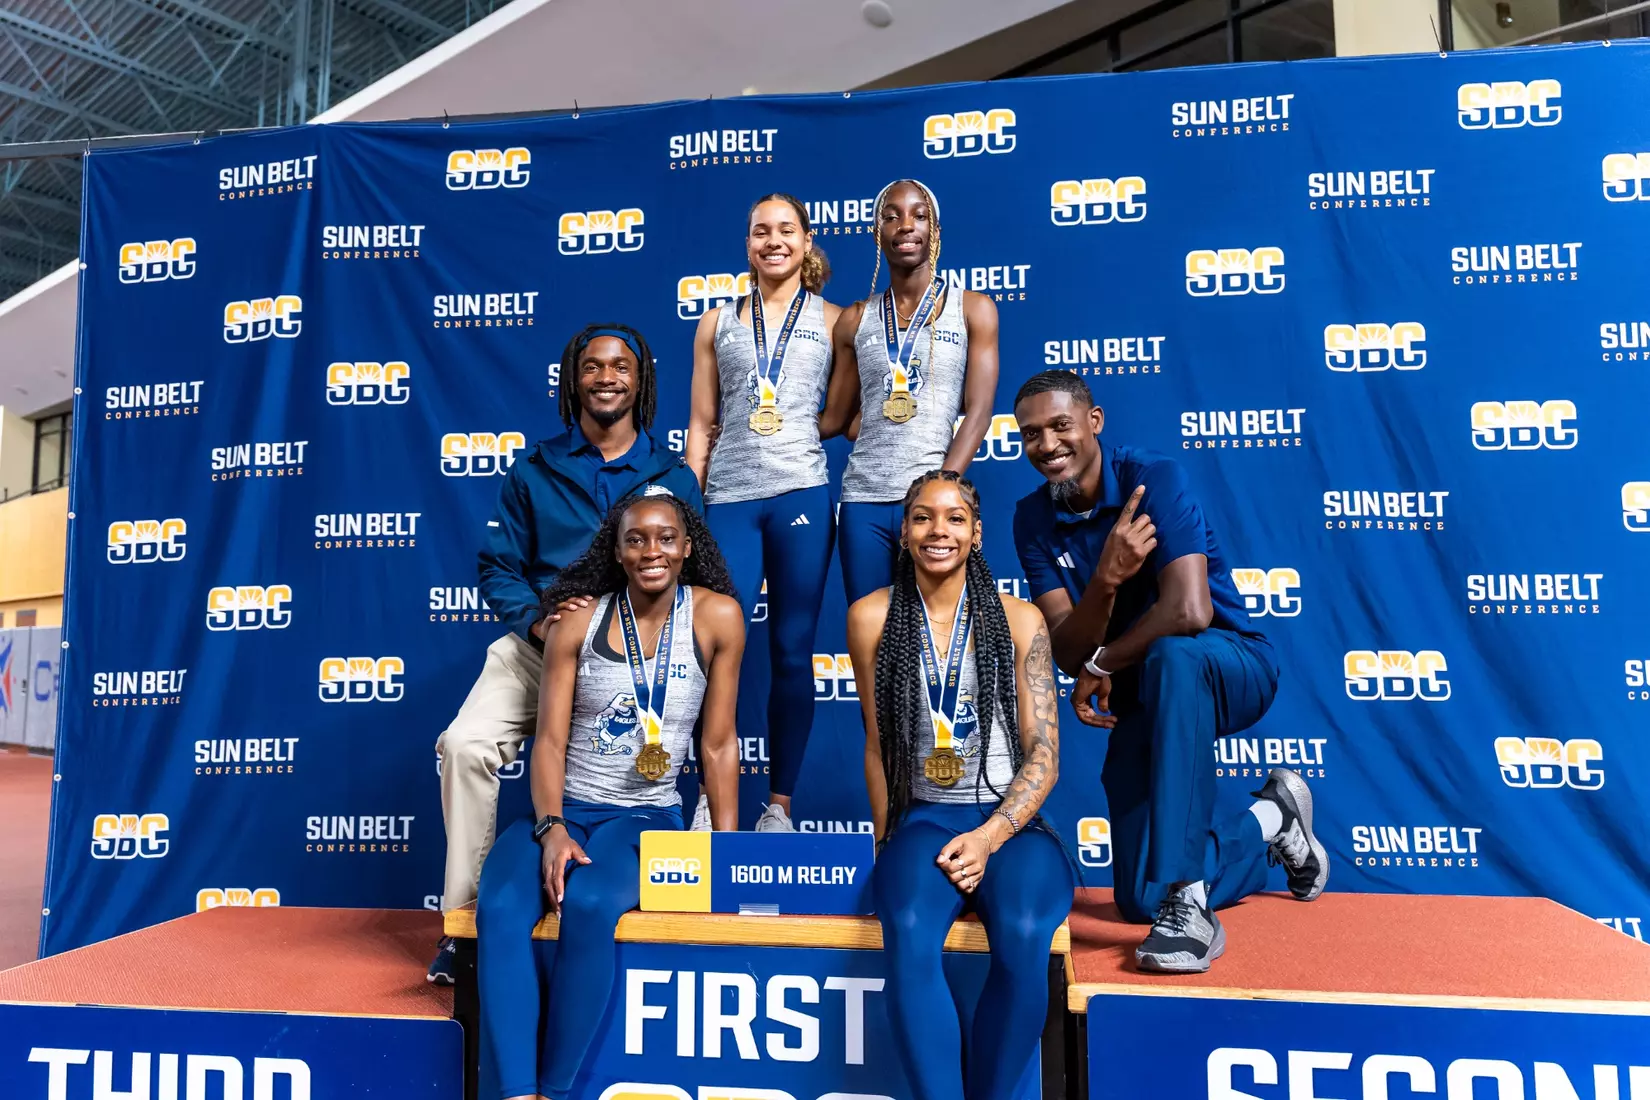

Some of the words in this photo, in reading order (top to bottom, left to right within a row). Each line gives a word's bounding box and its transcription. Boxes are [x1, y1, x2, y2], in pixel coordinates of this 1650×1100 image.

[1172, 100, 1226, 125] SUN
[1233, 94, 1294, 122] BELT
[1458, 79, 1562, 129] SBC
[924, 109, 1016, 159] SBC
[1173, 123, 1288, 137] CONFERENCE
[670, 130, 717, 158] SUN
[723, 129, 777, 152] BELT
[220, 164, 263, 189] SUN
[268, 155, 317, 184] BELT
[446, 147, 531, 190] SBC
[670, 155, 772, 169] CONFERENCE
[220, 182, 312, 200] CONFERENCE
[1309, 172, 1365, 197] SUN
[1371, 169, 1435, 195] BELT
[804, 200, 839, 224] UN
[844, 198, 875, 222] BE
[1051, 176, 1146, 226] SBC
[1310, 198, 1430, 209] CONFERENCE
[323, 226, 369, 247] SUN
[374, 225, 425, 247] BELT
[558, 208, 644, 255] SBC
[810, 225, 875, 236] NFEREN
[119, 238, 196, 283] SBC
[323, 250, 418, 259] CONFERENCE
[1452, 246, 1510, 272] SUN
[1516, 243, 1582, 269] BELT
[971, 264, 1031, 291] BELT
[1186, 247, 1285, 296] SBC
[1454, 272, 1577, 284] CONFERENCE
[434, 295, 480, 317] SUN
[485, 292, 538, 315] BELT
[224, 295, 302, 343] SBC
[434, 318, 533, 328] CONFERENCE
[794, 329, 819, 342] SBC
[1324, 322, 1426, 372] SBC
[1045, 339, 1098, 364] SUN
[1104, 337, 1165, 362] BELT
[326, 361, 410, 405] SBC
[1046, 365, 1161, 376] NFERENCE
[106, 385, 150, 408] SUN
[154, 381, 204, 405] BELT
[106, 407, 198, 419] CONFERENCE
[1181, 411, 1237, 436] SUN
[1242, 409, 1306, 435] BELT
[1471, 400, 1578, 450] SBC
[212, 444, 250, 470] SUN
[255, 441, 308, 465] BELT
[1183, 438, 1301, 449] CONFERENCE
[212, 468, 302, 481] CONFERENCE
[1324, 491, 1380, 516] SUN
[1383, 492, 1449, 517] BELT
[315, 514, 361, 537] SUN
[366, 513, 421, 535] BELT
[1326, 521, 1444, 530] CONFERENCE
[107, 518, 186, 564] SBC
[315, 540, 415, 549] CONFERENCE
[430, 587, 478, 609] SUN
[1230, 568, 1302, 617] BC
[1467, 574, 1529, 600] SUN
[1535, 574, 1603, 600] BELT
[206, 585, 292, 631] SBC
[430, 614, 500, 622] CONFERE
[1469, 605, 1599, 613] CONFERENCE
[625, 616, 633, 634] BELT
[628, 636, 644, 686] CONFERENCE
[921, 634, 938, 686] CONFERENCE
[948, 670, 956, 687] SUN
[952, 648, 960, 667] BELT
[94, 672, 137, 695] SUN
[141, 669, 187, 694] BELT
[319, 657, 404, 702] SBC
[812, 653, 860, 701] SB
[1344, 650, 1451, 701] SBC
[93, 697, 180, 706] CONFERENCE
[195, 739, 240, 763] SUN
[245, 738, 299, 762] BELT
[737, 737, 770, 761] EL
[1264, 738, 1328, 764] BELT
[195, 766, 293, 775] CONFERENCE
[1494, 737, 1604, 790] SBC
[91, 813, 169, 859] SBC
[307, 816, 354, 839] SUN
[359, 816, 414, 839] BELT
[1352, 826, 1409, 853] SUN
[1414, 827, 1482, 853] BELT
[306, 844, 408, 852] CONFERENCE
[648, 857, 700, 885] SBC
[730, 864, 774, 884] 1600
[778, 866, 793, 884] M
[797, 866, 857, 885] RELAY
[1356, 857, 1478, 867] CONFERENCE
[625, 969, 885, 1065] FIRST
